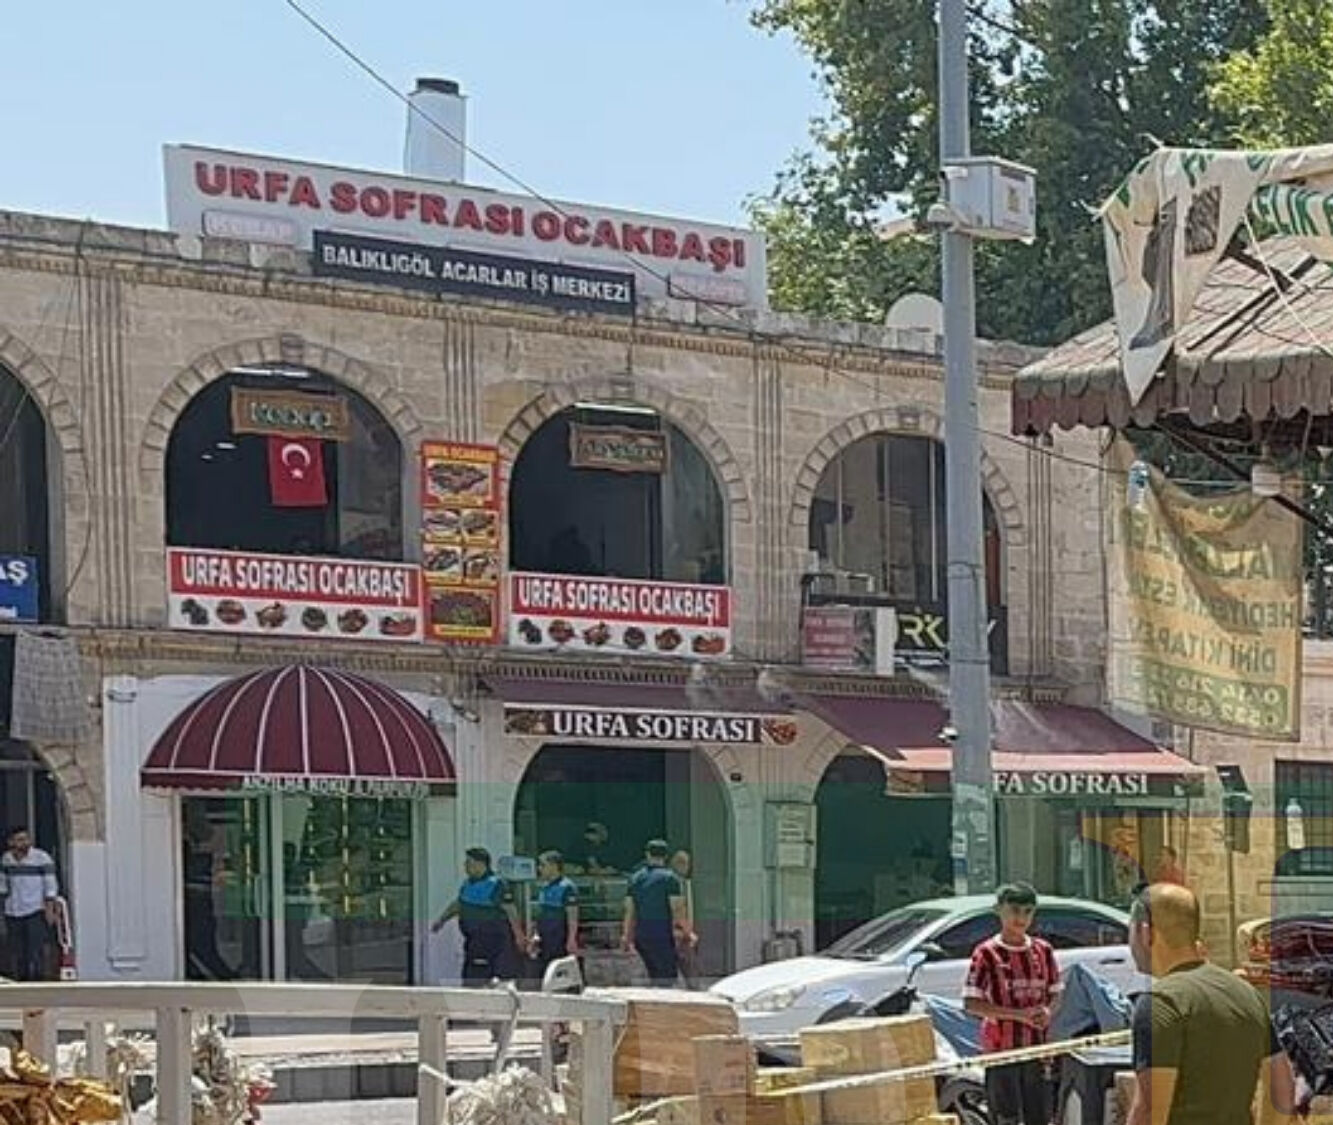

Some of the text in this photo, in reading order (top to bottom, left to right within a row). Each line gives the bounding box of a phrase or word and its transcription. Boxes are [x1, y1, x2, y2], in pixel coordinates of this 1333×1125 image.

[195, 161, 321, 209] URFA
[329, 181, 524, 237] SOFRASI
[531, 209, 746, 272] OCAKBAŞI
[441, 260, 527, 289] ACARLAR
[531, 271, 549, 294] İŞ
[552, 276, 631, 303] MERKEZİ
[0, 560, 29, 588] Ş
[181, 554, 411, 605] URFA SOFRASI OCAKBAŞI
[519, 578, 720, 626] URFA SOFRASI OCAKBAŞI
[551, 711, 755, 741] URFA SOFRASI
[993, 771, 1149, 796] FA SOFRASI
